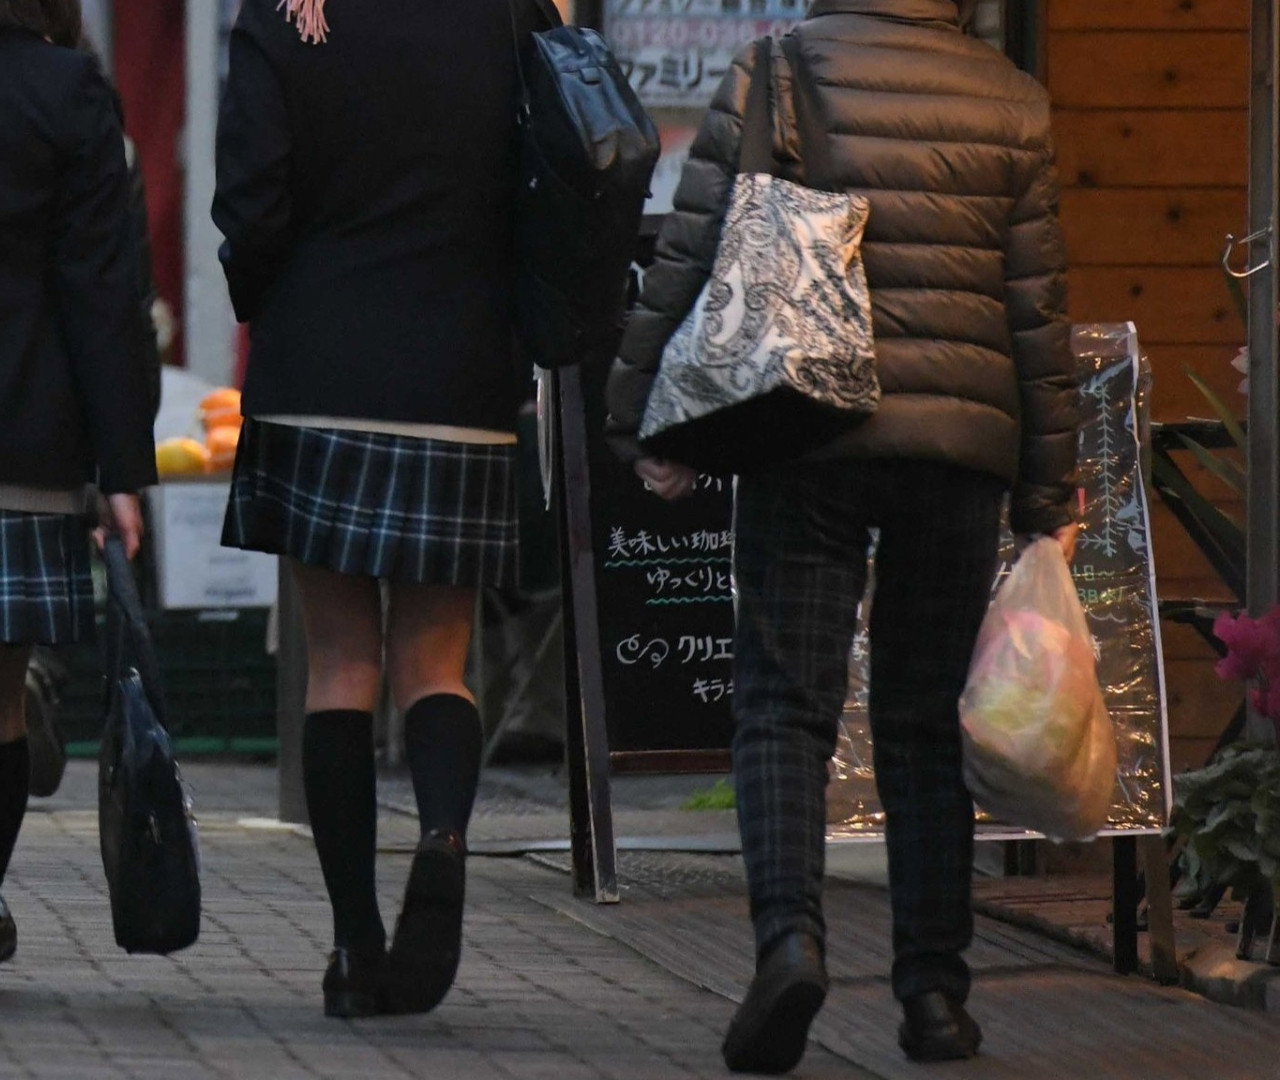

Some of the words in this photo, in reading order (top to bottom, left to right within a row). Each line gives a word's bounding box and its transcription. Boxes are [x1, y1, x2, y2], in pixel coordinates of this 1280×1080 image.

[647, 567, 731, 594] ゆっくりと
[678, 635, 735, 664] クリエ
